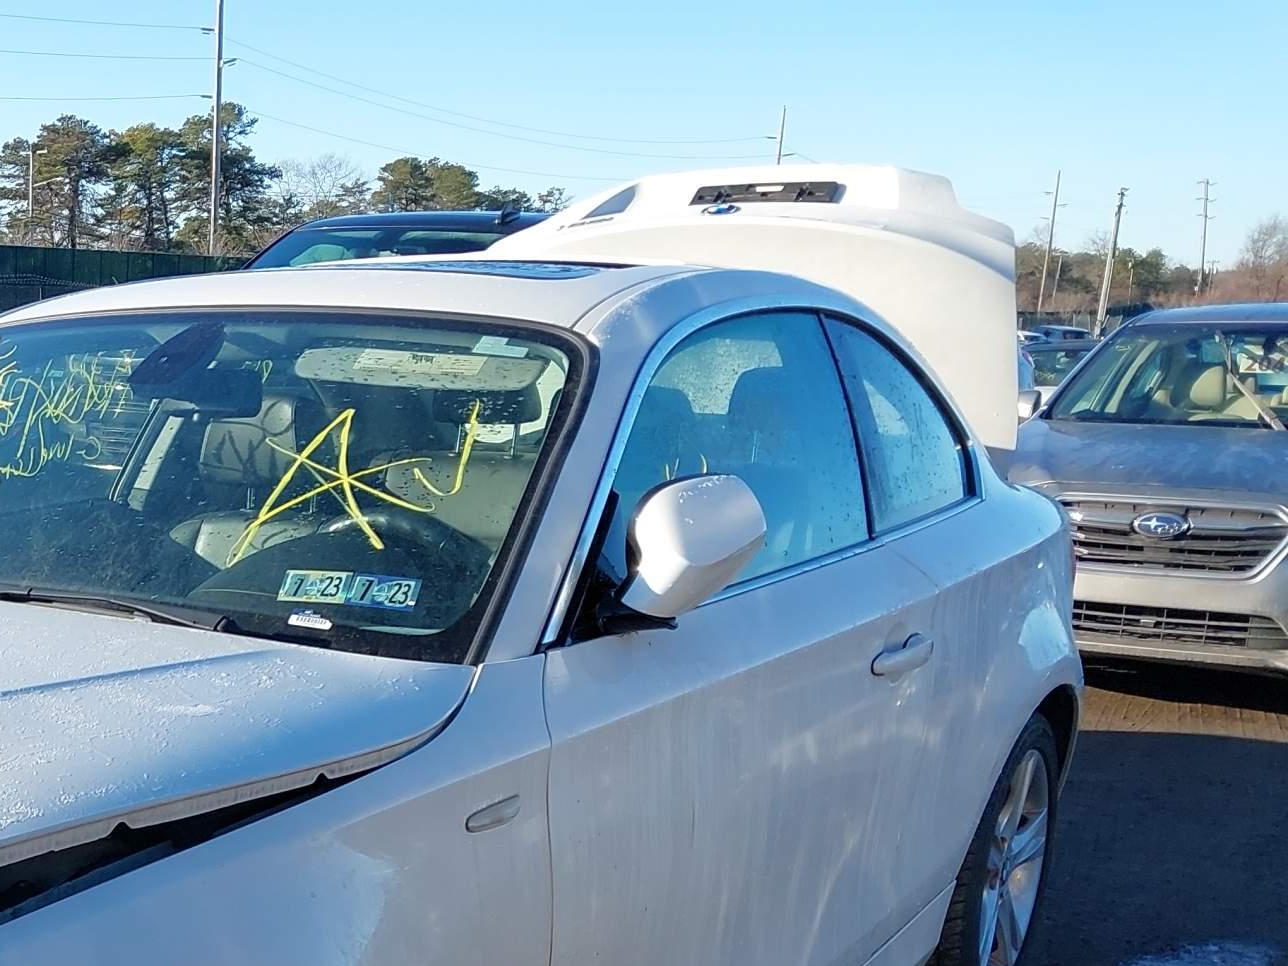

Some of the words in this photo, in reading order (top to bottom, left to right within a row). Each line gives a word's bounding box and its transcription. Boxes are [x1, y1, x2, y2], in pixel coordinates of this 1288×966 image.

[292, 577, 305, 597] 7
[319, 576, 344, 598] 23
[360, 579, 374, 602] 7
[387, 582, 413, 605] 23
